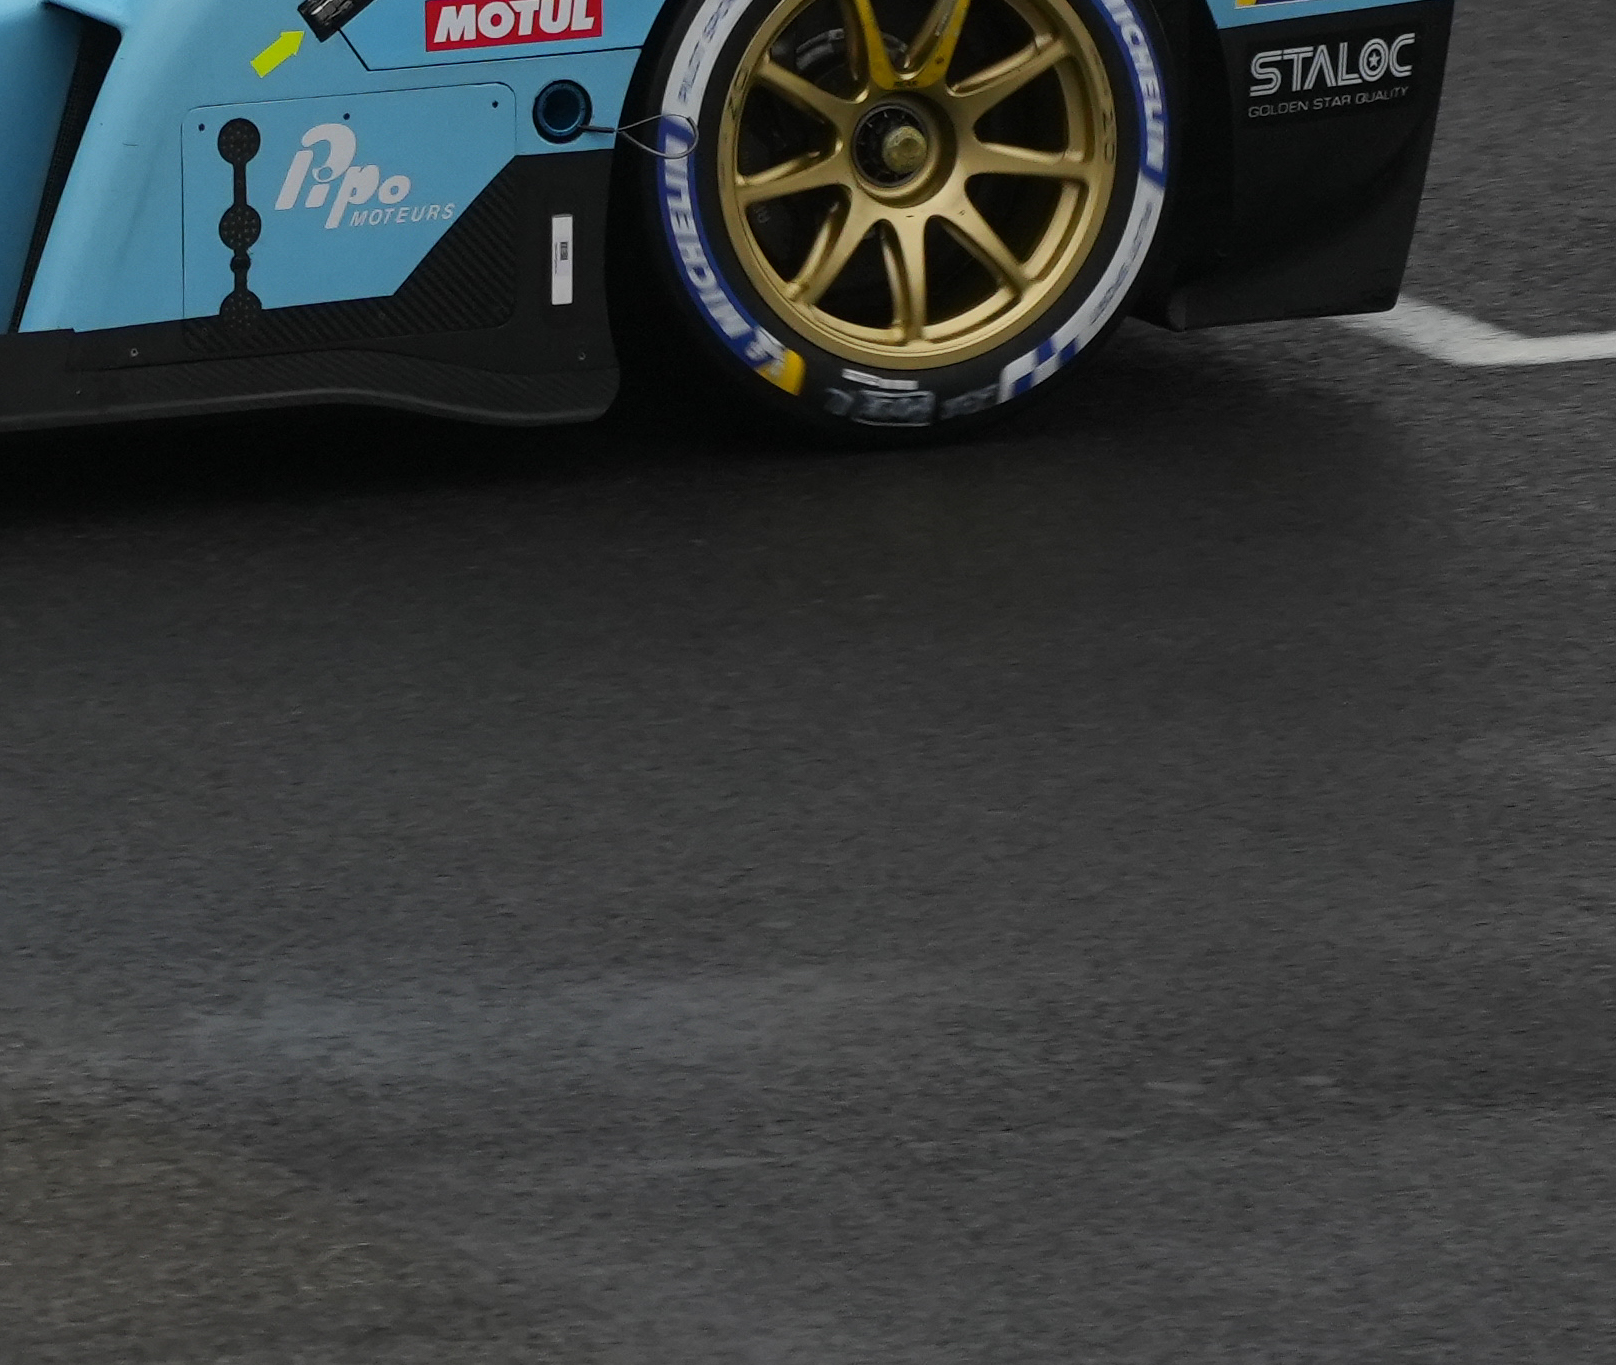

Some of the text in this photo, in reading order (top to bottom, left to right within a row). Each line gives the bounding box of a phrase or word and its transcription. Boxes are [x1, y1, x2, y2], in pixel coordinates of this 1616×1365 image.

[1249, 33, 1415, 97] STALOC
[1247, 85, 1410, 119] GOLDEN STAR QUALITY
[275, 122, 412, 230] Pipo
[349, 201, 455, 228] MOTEURS
